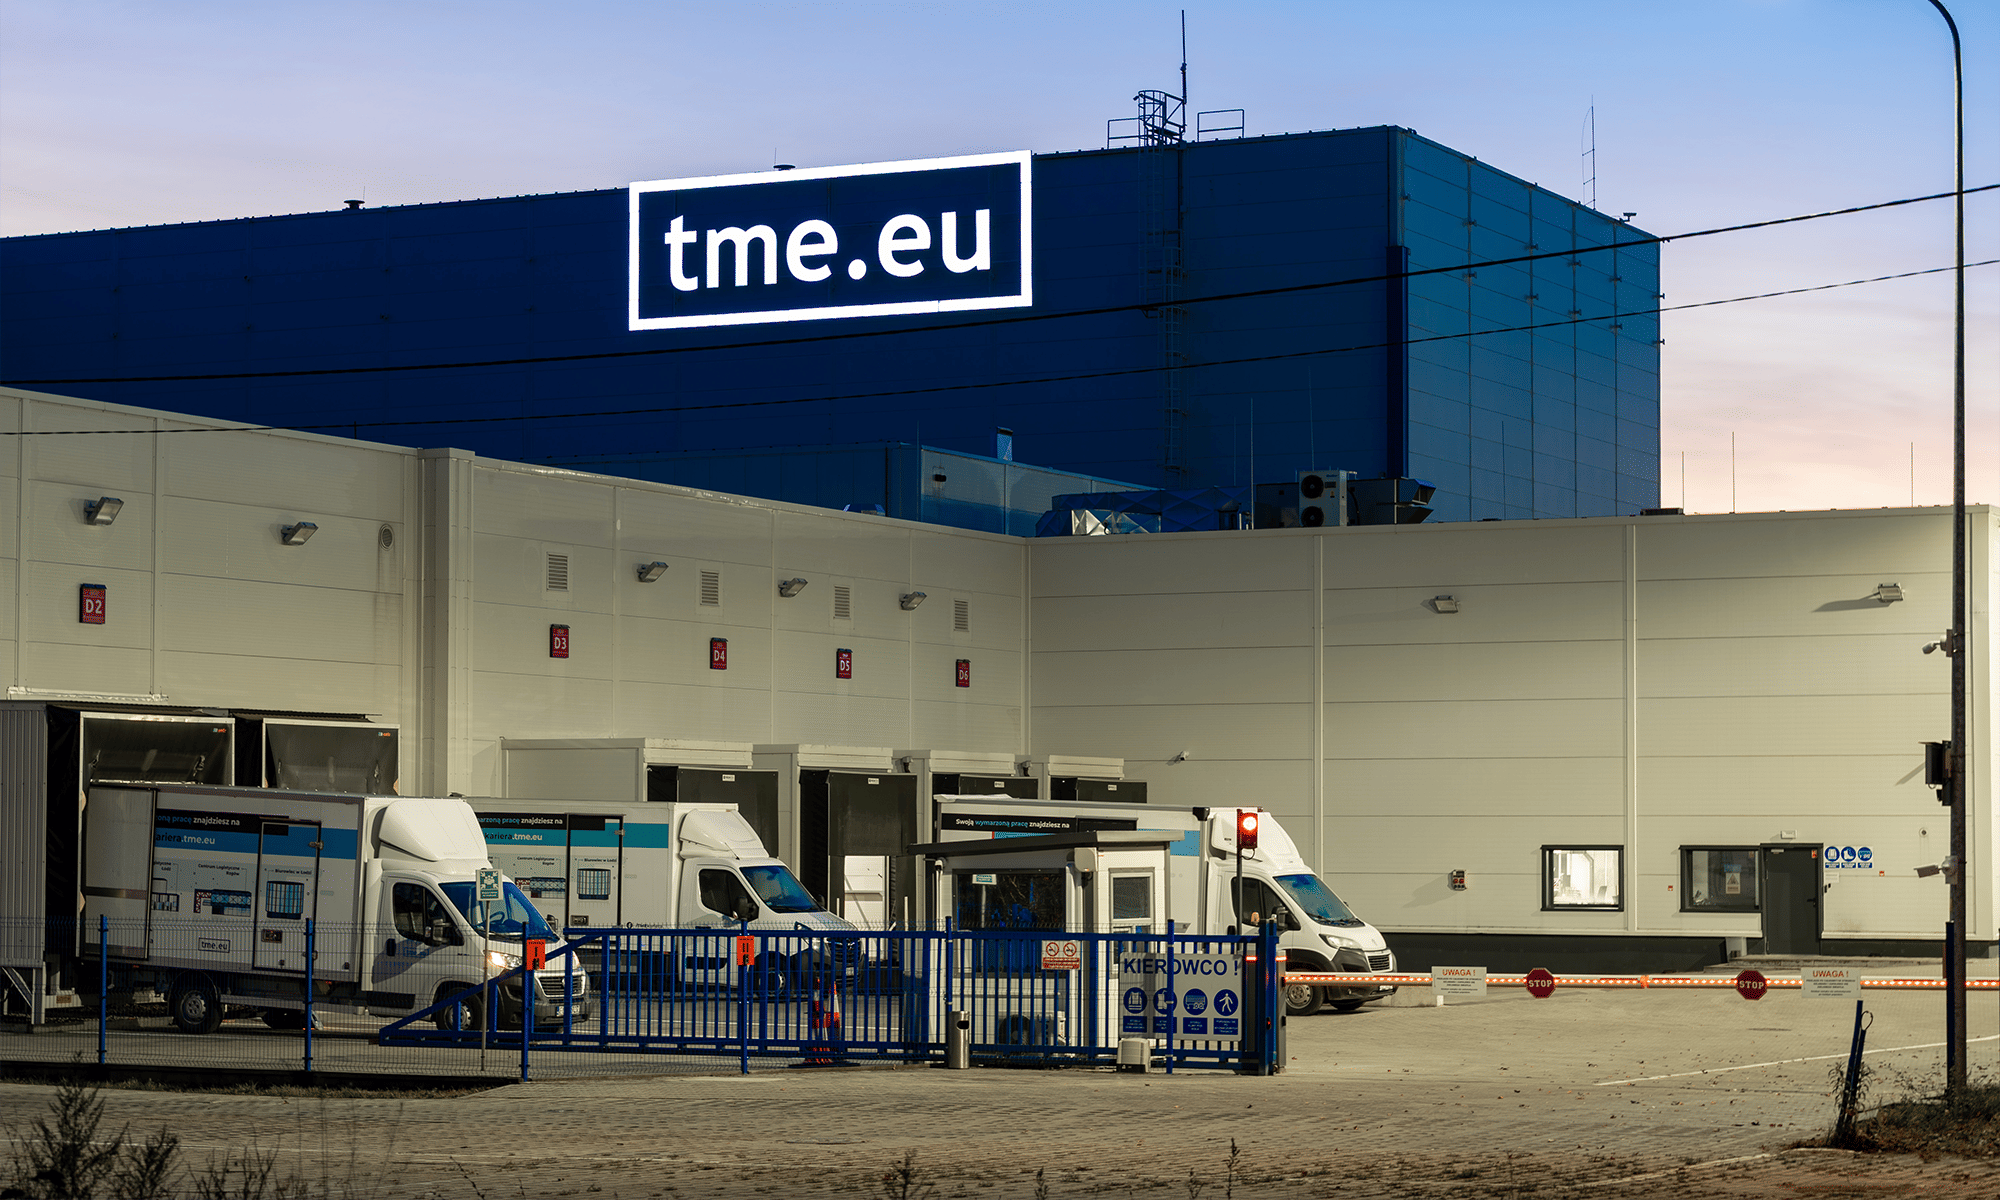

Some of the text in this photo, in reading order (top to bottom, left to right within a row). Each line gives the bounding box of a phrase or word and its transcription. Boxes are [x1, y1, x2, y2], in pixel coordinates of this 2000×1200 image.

[664, 208, 991, 292] tme.eu
[85, 598, 103, 615] D2
[554, 636, 567, 650] D3
[713, 649, 726, 662] D4
[839, 659, 851, 672] D5
[958, 669, 969, 681] D6
[172, 815, 192, 825] pracę
[193, 816, 230, 826] znajdziesz
[502, 817, 520, 825] pracę
[521, 817, 554, 825] znajdziesz
[955, 818, 974, 827] Swoją
[975, 819, 1010, 828] wymarzoną
[1010, 820, 1029, 828] pracę
[1029, 820, 1061, 829] znajdziesz
[155, 832, 216, 845] ariera.tme.eu
[484, 832, 543, 841] kariera.tme.eu
[201, 941, 228, 950] tme.eu
[1124, 958, 1239, 976] KIEROWCO !
[1442, 968, 1472, 977] UWAGA
[1812, 970, 1845, 978] UWAGA
[1528, 979, 1553, 988] STOP
[1739, 980, 1765, 989] STOP
